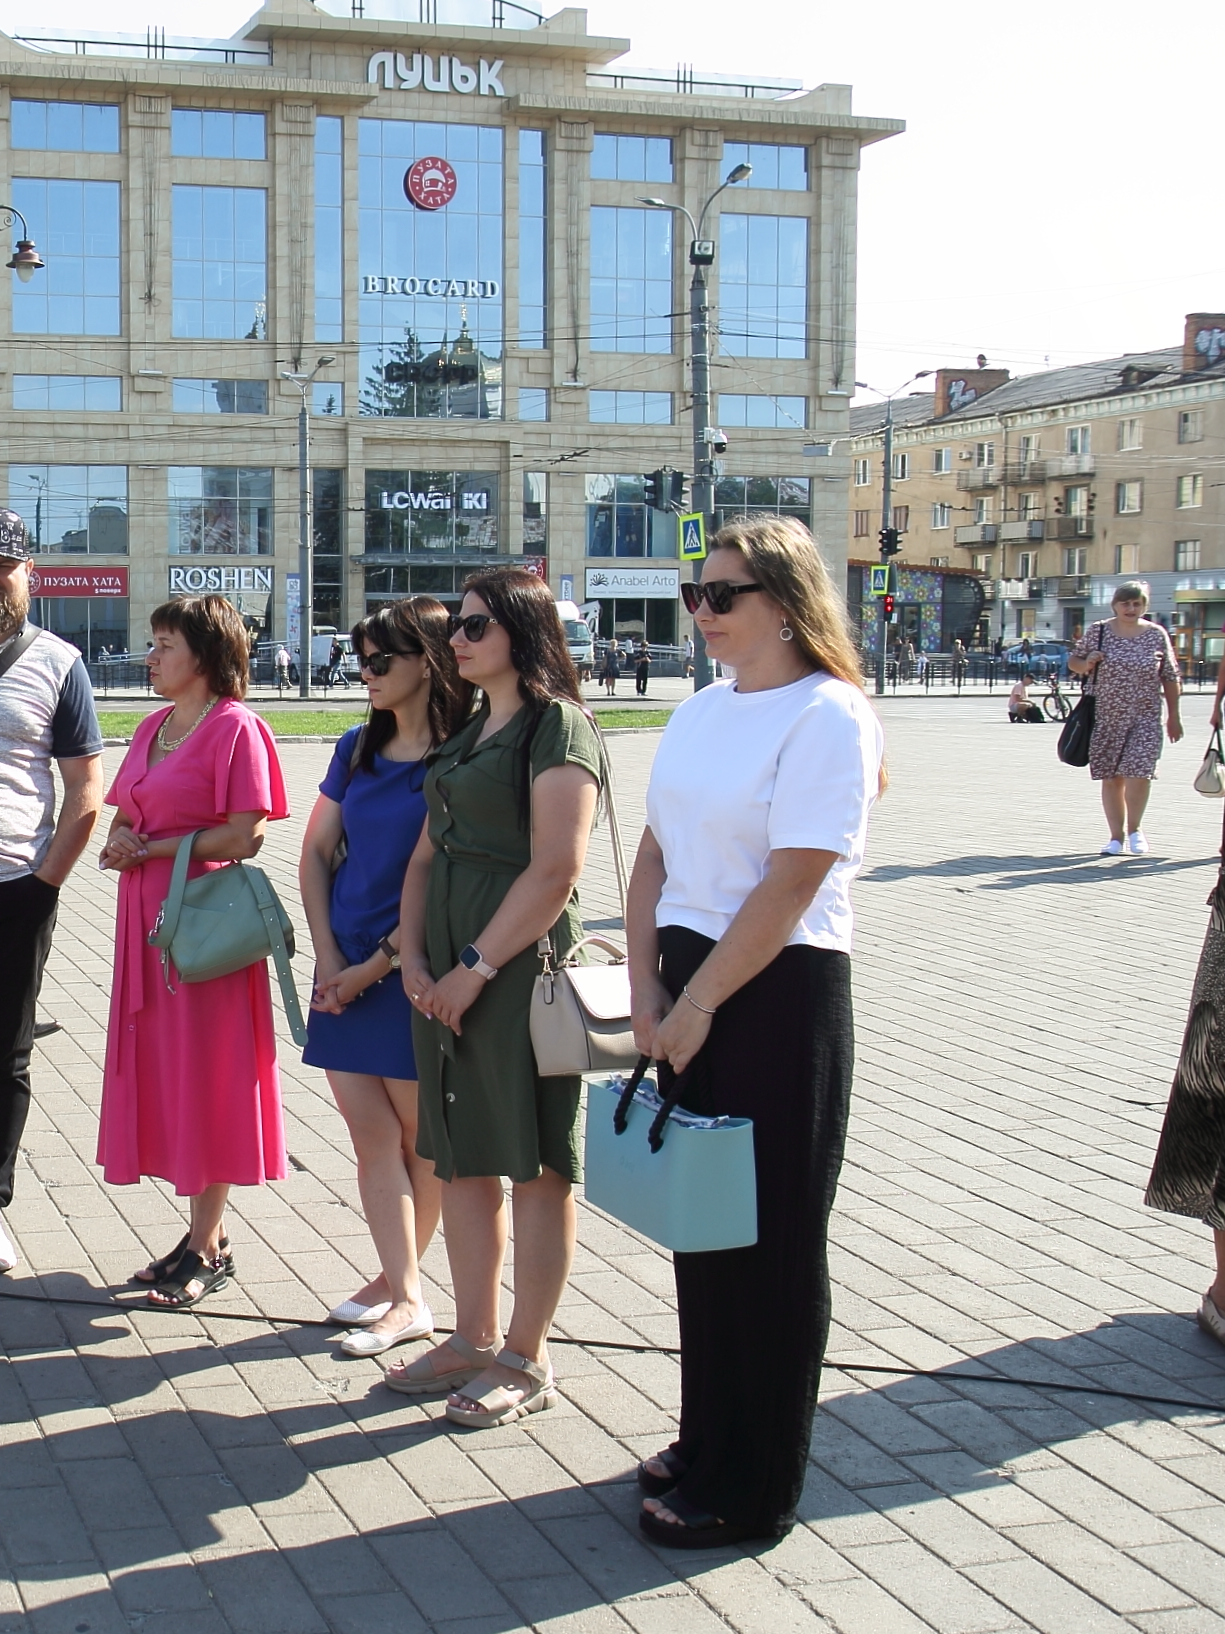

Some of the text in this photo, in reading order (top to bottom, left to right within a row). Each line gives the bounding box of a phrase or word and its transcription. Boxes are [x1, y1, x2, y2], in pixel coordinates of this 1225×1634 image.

[413, 160, 454, 184] ПУЗАТА
[419, 191, 450, 204] ХАТА
[365, 275, 499, 297] BROCARD
[44, 577, 89, 586] ПУЗАТА
[92, 577, 121, 586] ХАТА
[170, 567, 272, 592] ROSHEN
[611, 575, 676, 586] Anabel Arto
